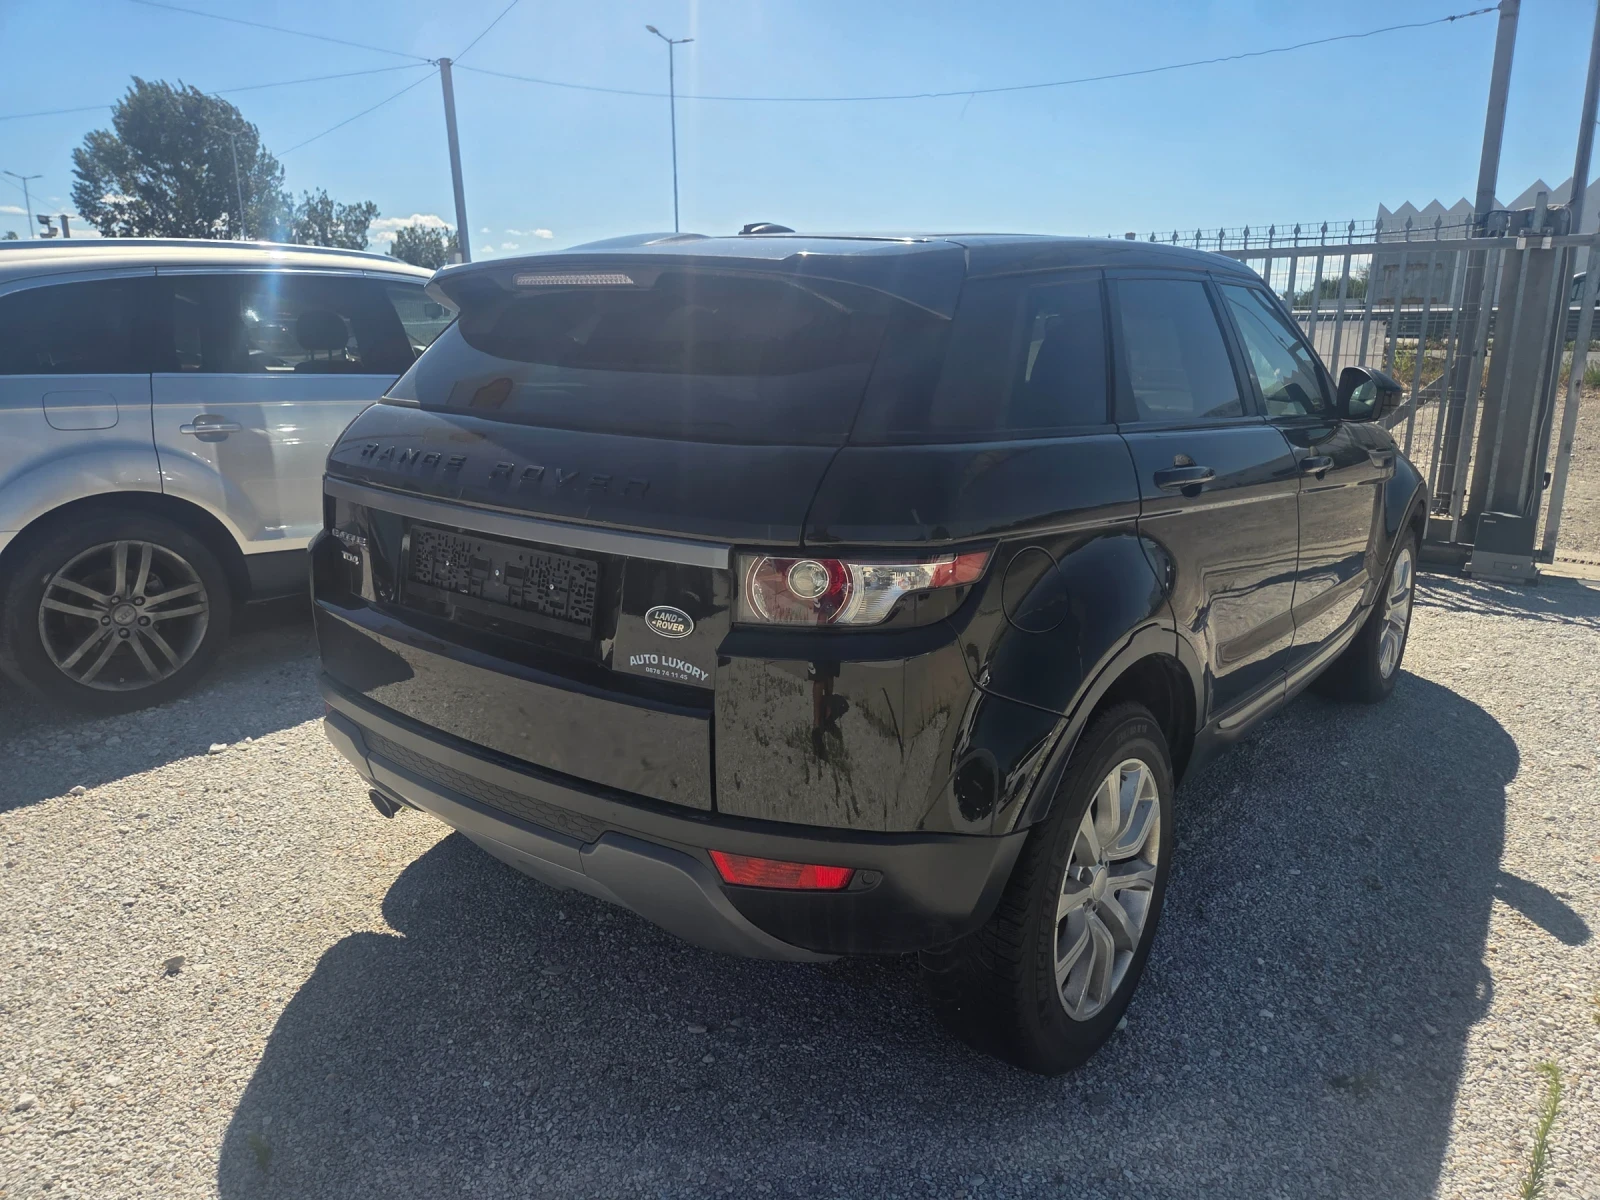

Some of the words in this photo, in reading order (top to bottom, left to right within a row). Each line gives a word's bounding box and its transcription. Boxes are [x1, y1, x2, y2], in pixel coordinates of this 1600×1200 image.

[361, 442, 467, 473] RANGE
[489, 461, 650, 497] ROVER
[654, 611, 678, 622] LAND
[656, 620, 685, 632] ROVER
[630, 654, 659, 666] AUTO
[662, 655, 709, 681] LUXORY
